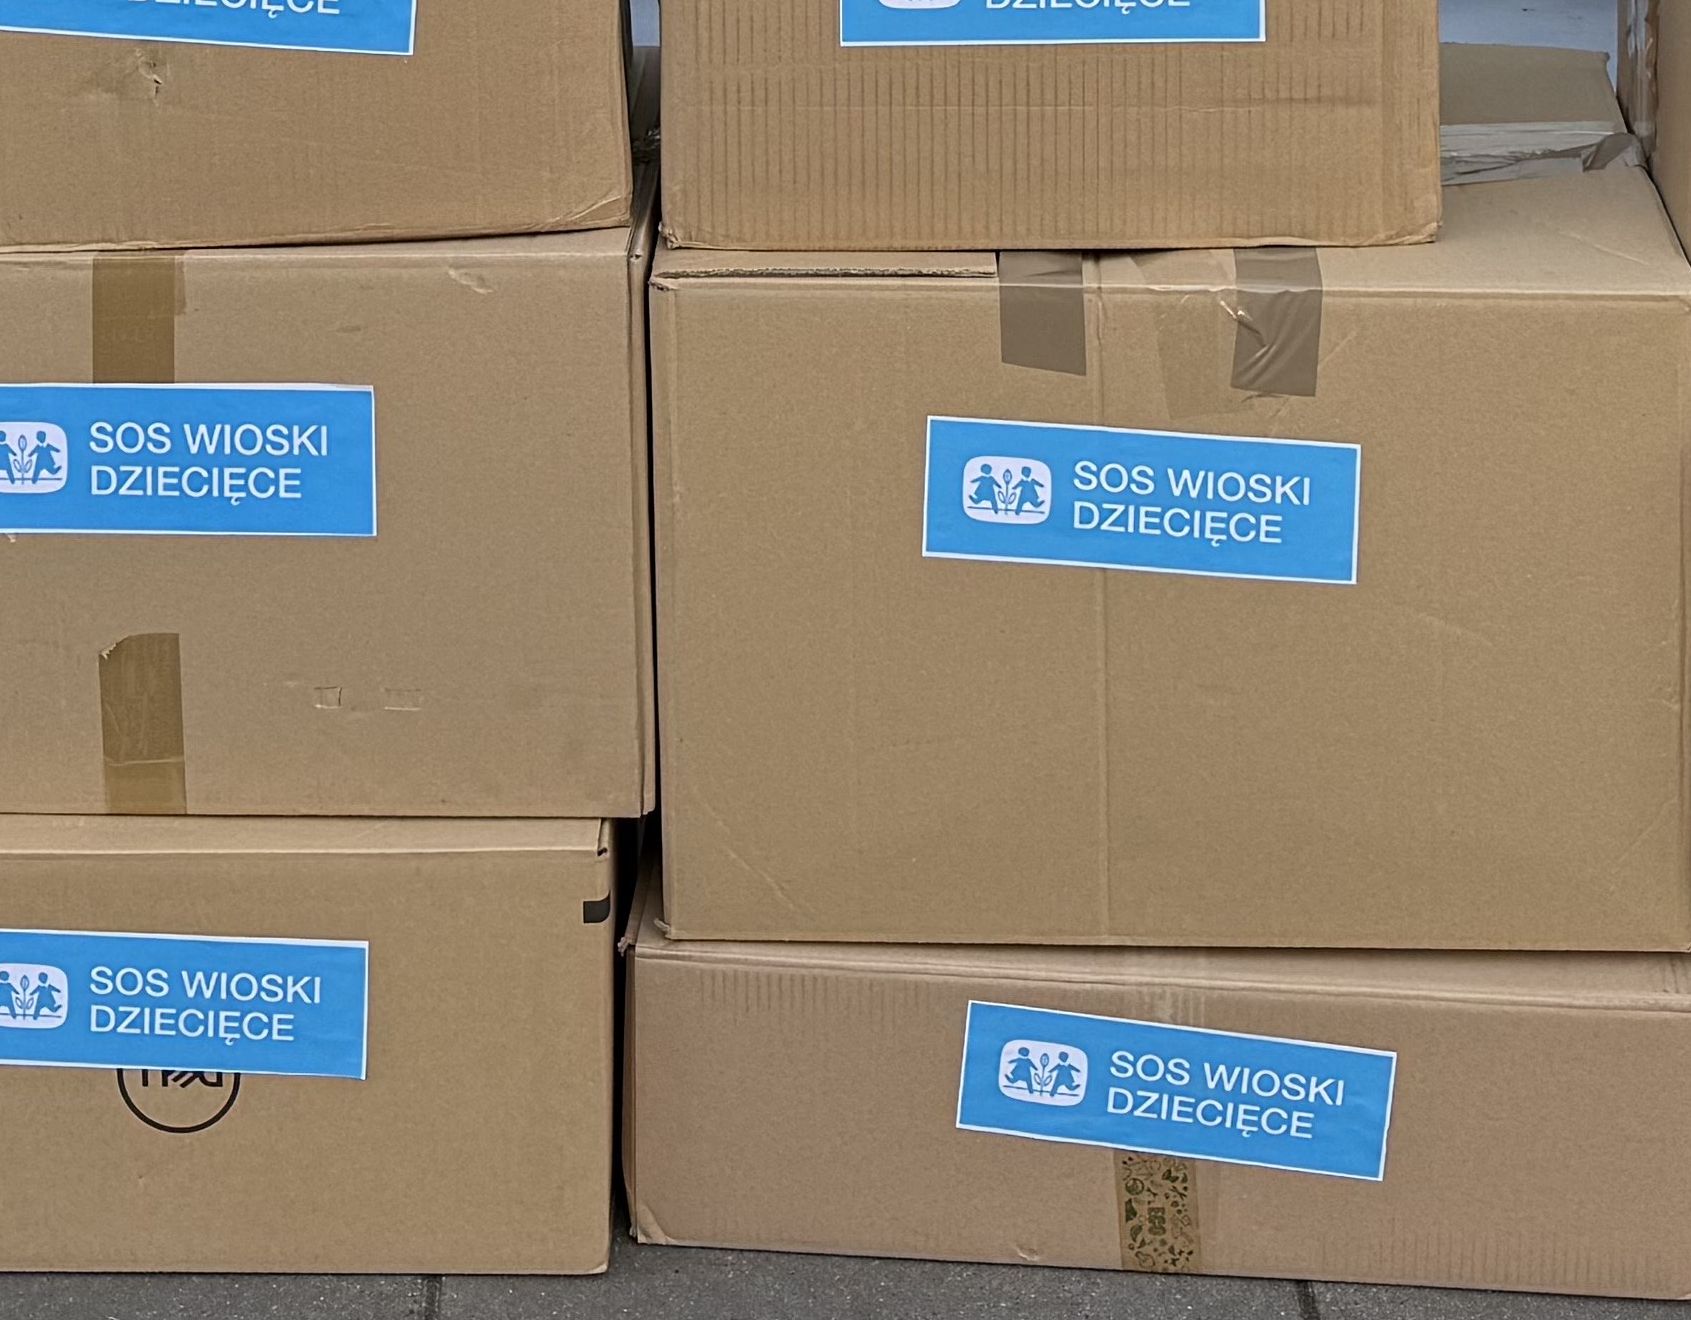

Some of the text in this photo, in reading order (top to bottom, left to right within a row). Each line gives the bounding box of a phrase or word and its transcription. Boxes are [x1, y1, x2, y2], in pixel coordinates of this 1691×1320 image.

[90, 422, 327, 455] SOS WIOSKI
[92, 466, 301, 505] DZIECIĘCE
[1074, 461, 1309, 505] SOS WIOSKI
[1074, 502, 1282, 546] DZIECIĘCE
[91, 966, 320, 1003] SOS WIOSKI
[91, 1005, 294, 1045] DZIECIĘCE
[1110, 1051, 1345, 1106] SOS WIOSKI
[1107, 1087, 1314, 1139] DZIECIĘCE
